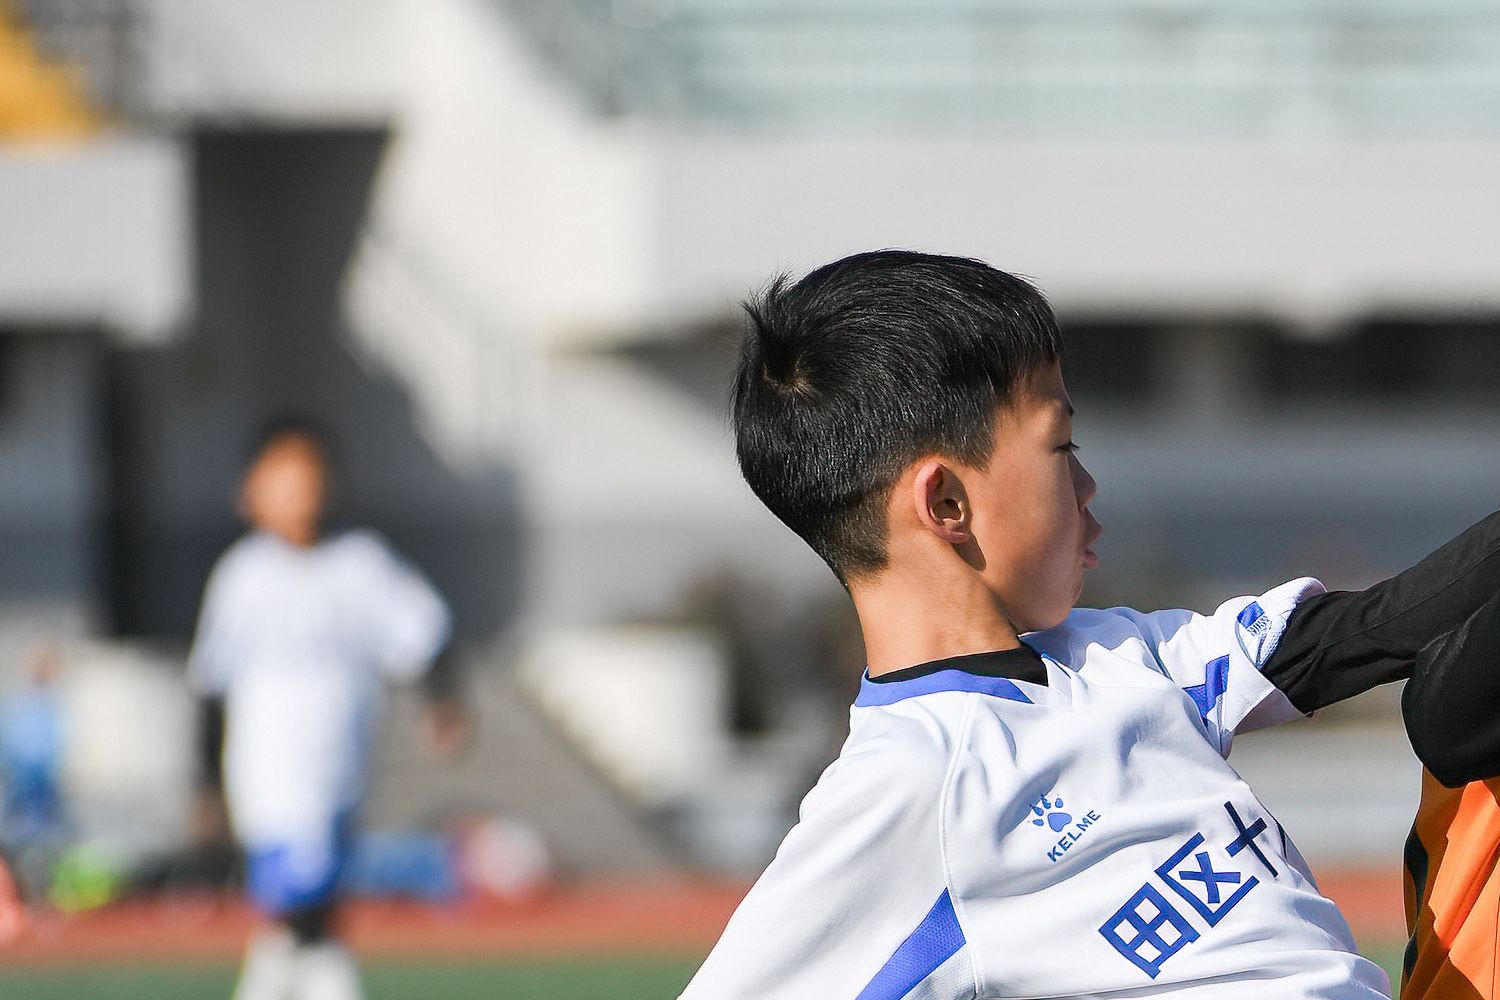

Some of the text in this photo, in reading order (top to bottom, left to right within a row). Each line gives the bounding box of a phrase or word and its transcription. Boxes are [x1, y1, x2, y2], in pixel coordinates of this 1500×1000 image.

[1046, 810, 1101, 862] KELME
[1098, 801, 1288, 980] 田区十
